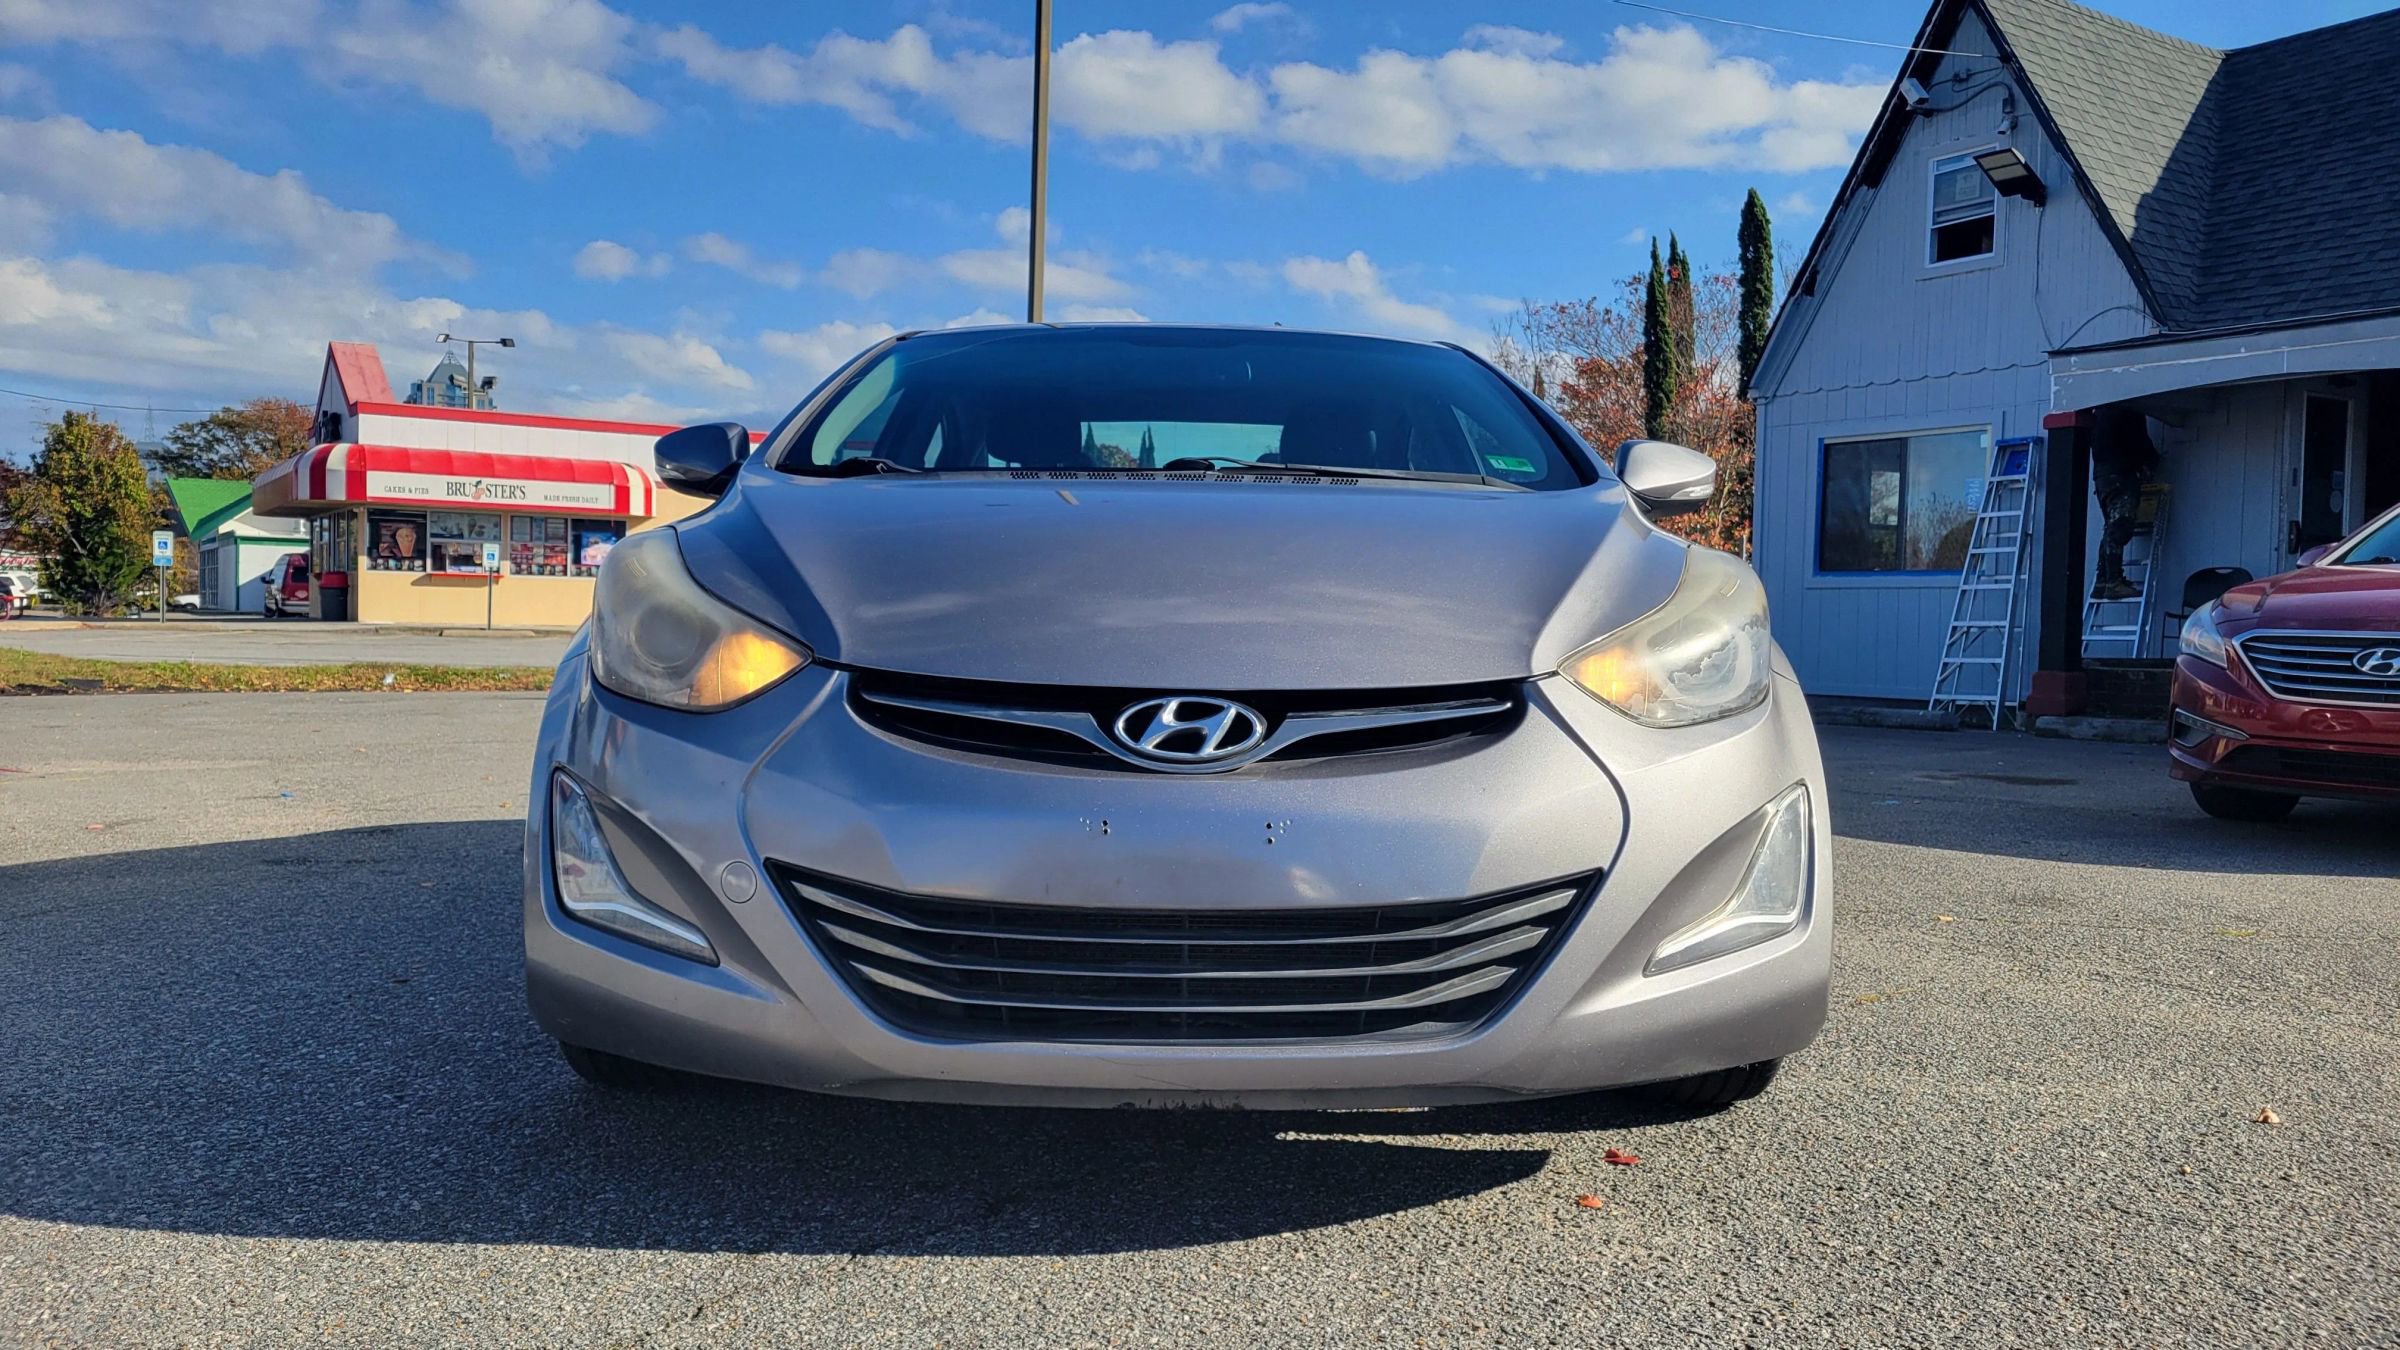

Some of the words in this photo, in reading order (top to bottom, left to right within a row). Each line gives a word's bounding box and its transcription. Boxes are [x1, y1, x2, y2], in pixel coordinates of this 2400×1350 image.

[384, 485, 406, 494] CAKES
[414, 487, 429, 495] PIES
[544, 494, 560, 502] MADE
[581, 496, 598, 504] DAILY
